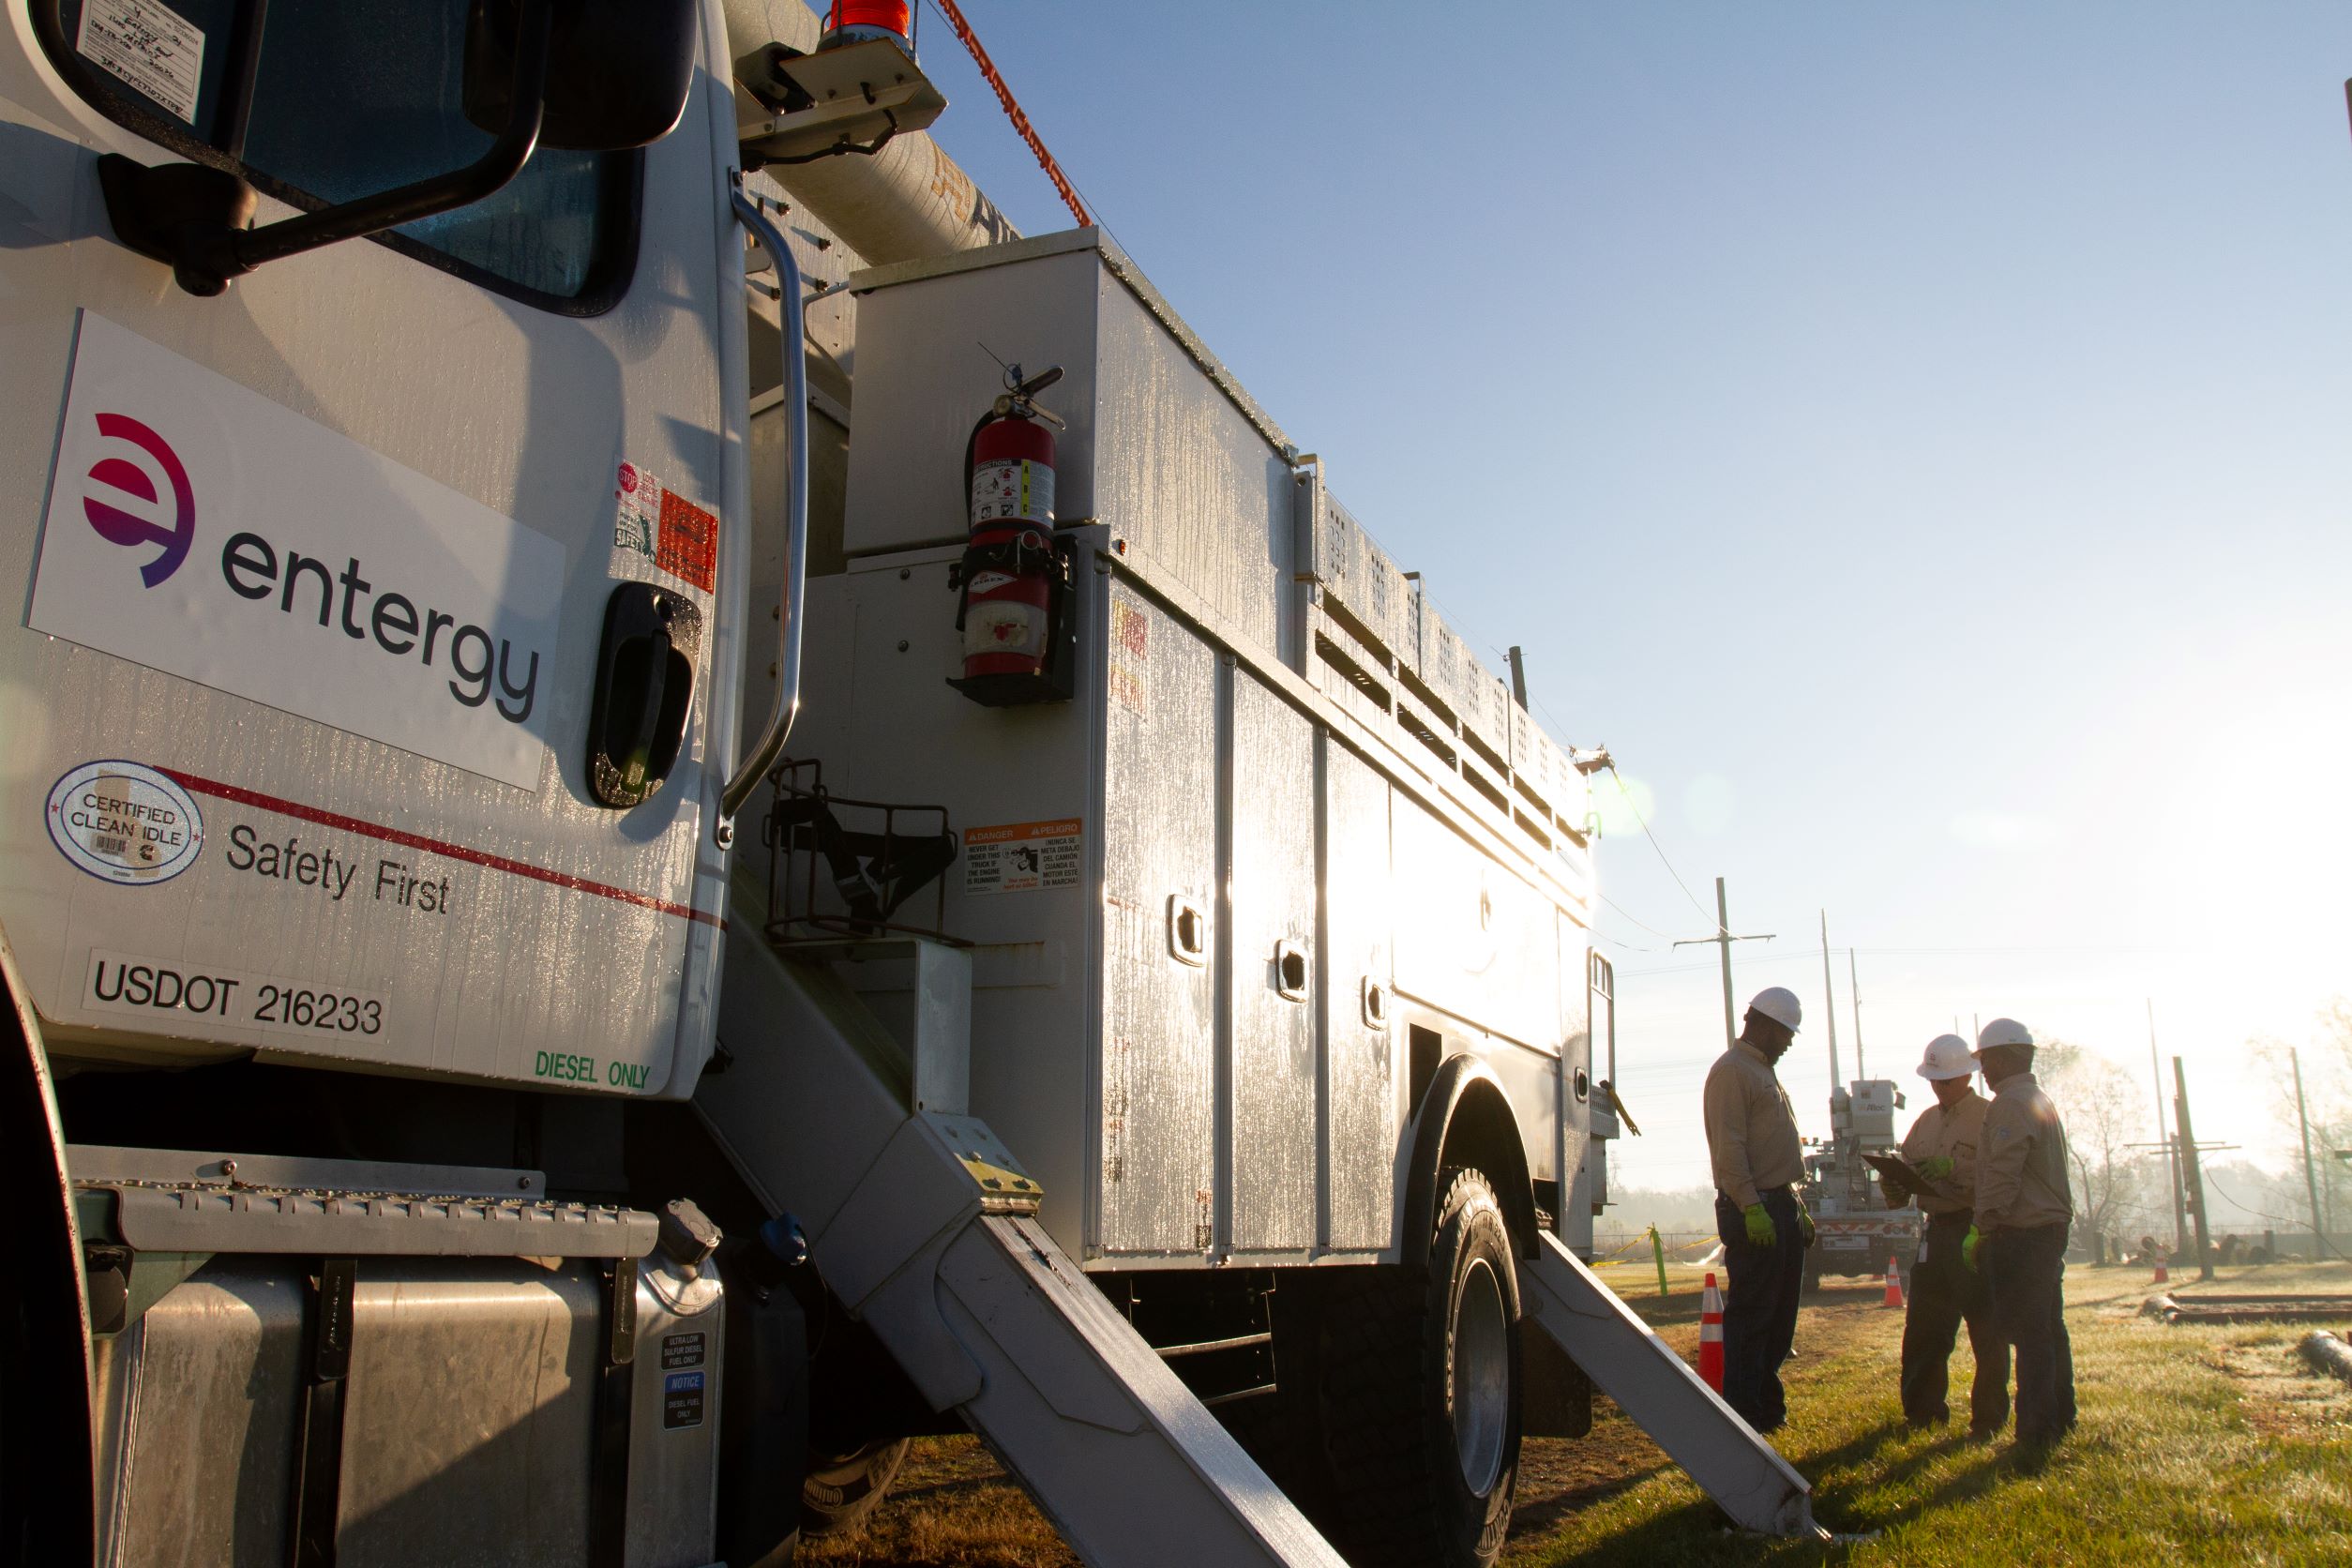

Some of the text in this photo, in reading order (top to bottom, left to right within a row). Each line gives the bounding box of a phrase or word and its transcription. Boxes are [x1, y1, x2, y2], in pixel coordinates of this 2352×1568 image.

[620, 469, 637, 487] STOP
[221, 532, 540, 725] entergy
[83, 793, 176, 825] CERTIFIED
[70, 811, 182, 847] CLEAN IDLE
[977, 823, 1078, 841] DANGER PELIGRO
[1057, 845, 1080, 853] DEBAJO
[227, 824, 450, 914] Safety First
[1052, 877, 1078, 885] MARCHA!
[95, 960, 382, 1034] USDOT 216233
[535, 1050, 650, 1089] DIESEL ONLY
[664, 1344, 702, 1356] SULFUR DIESEL
[671, 1376, 700, 1389] NOTICE
[669, 1397, 700, 1408] DIESEL FUEL
[677, 1410, 691, 1418] ONLY
